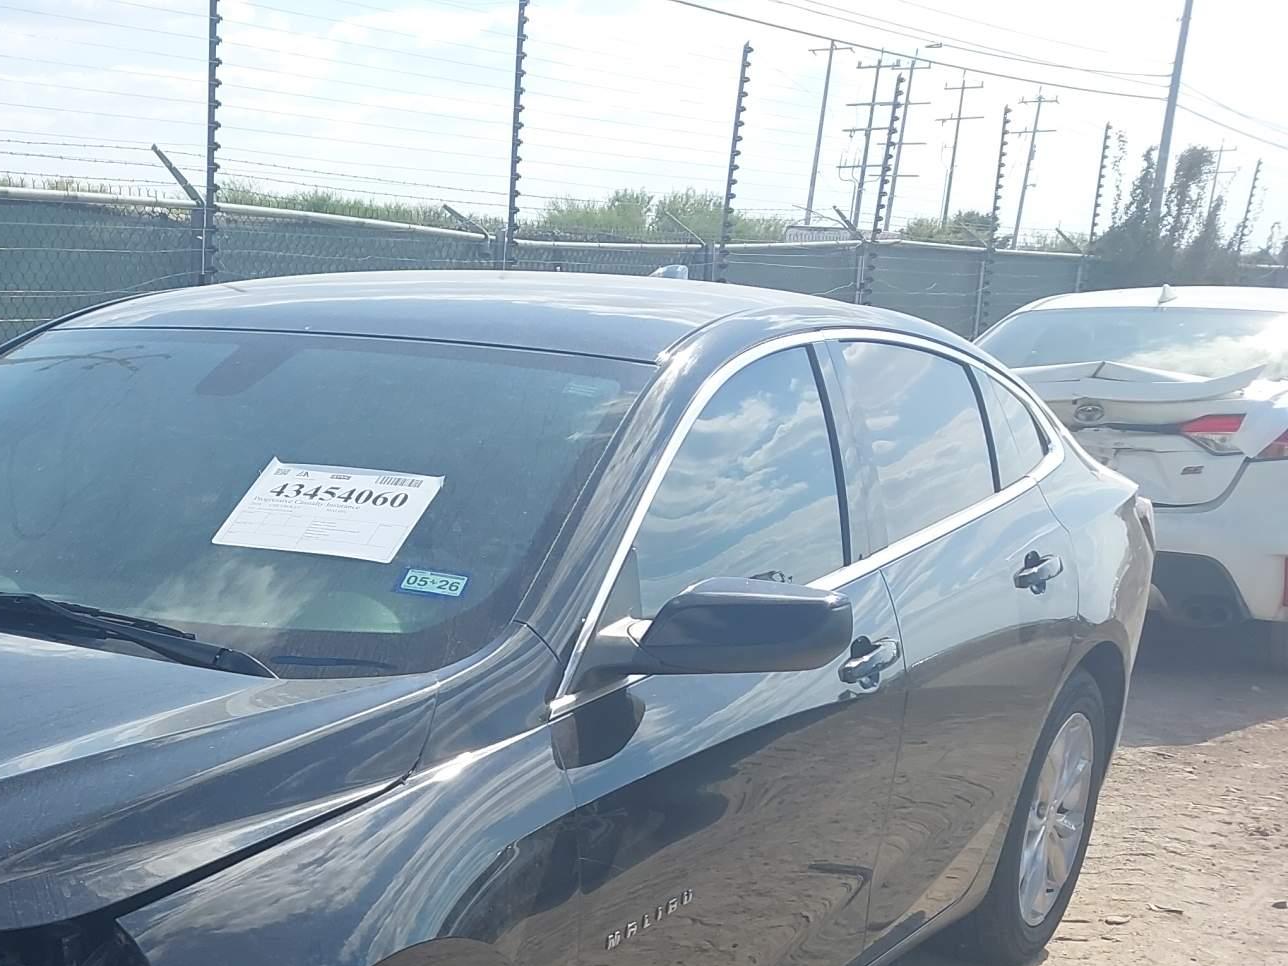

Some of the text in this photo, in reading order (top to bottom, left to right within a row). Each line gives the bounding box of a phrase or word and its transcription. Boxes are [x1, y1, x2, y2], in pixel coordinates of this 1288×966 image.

[270, 482, 409, 508] 43454060
[406, 575, 461, 592] 05 26
[607, 888, 694, 951] MALIBU
